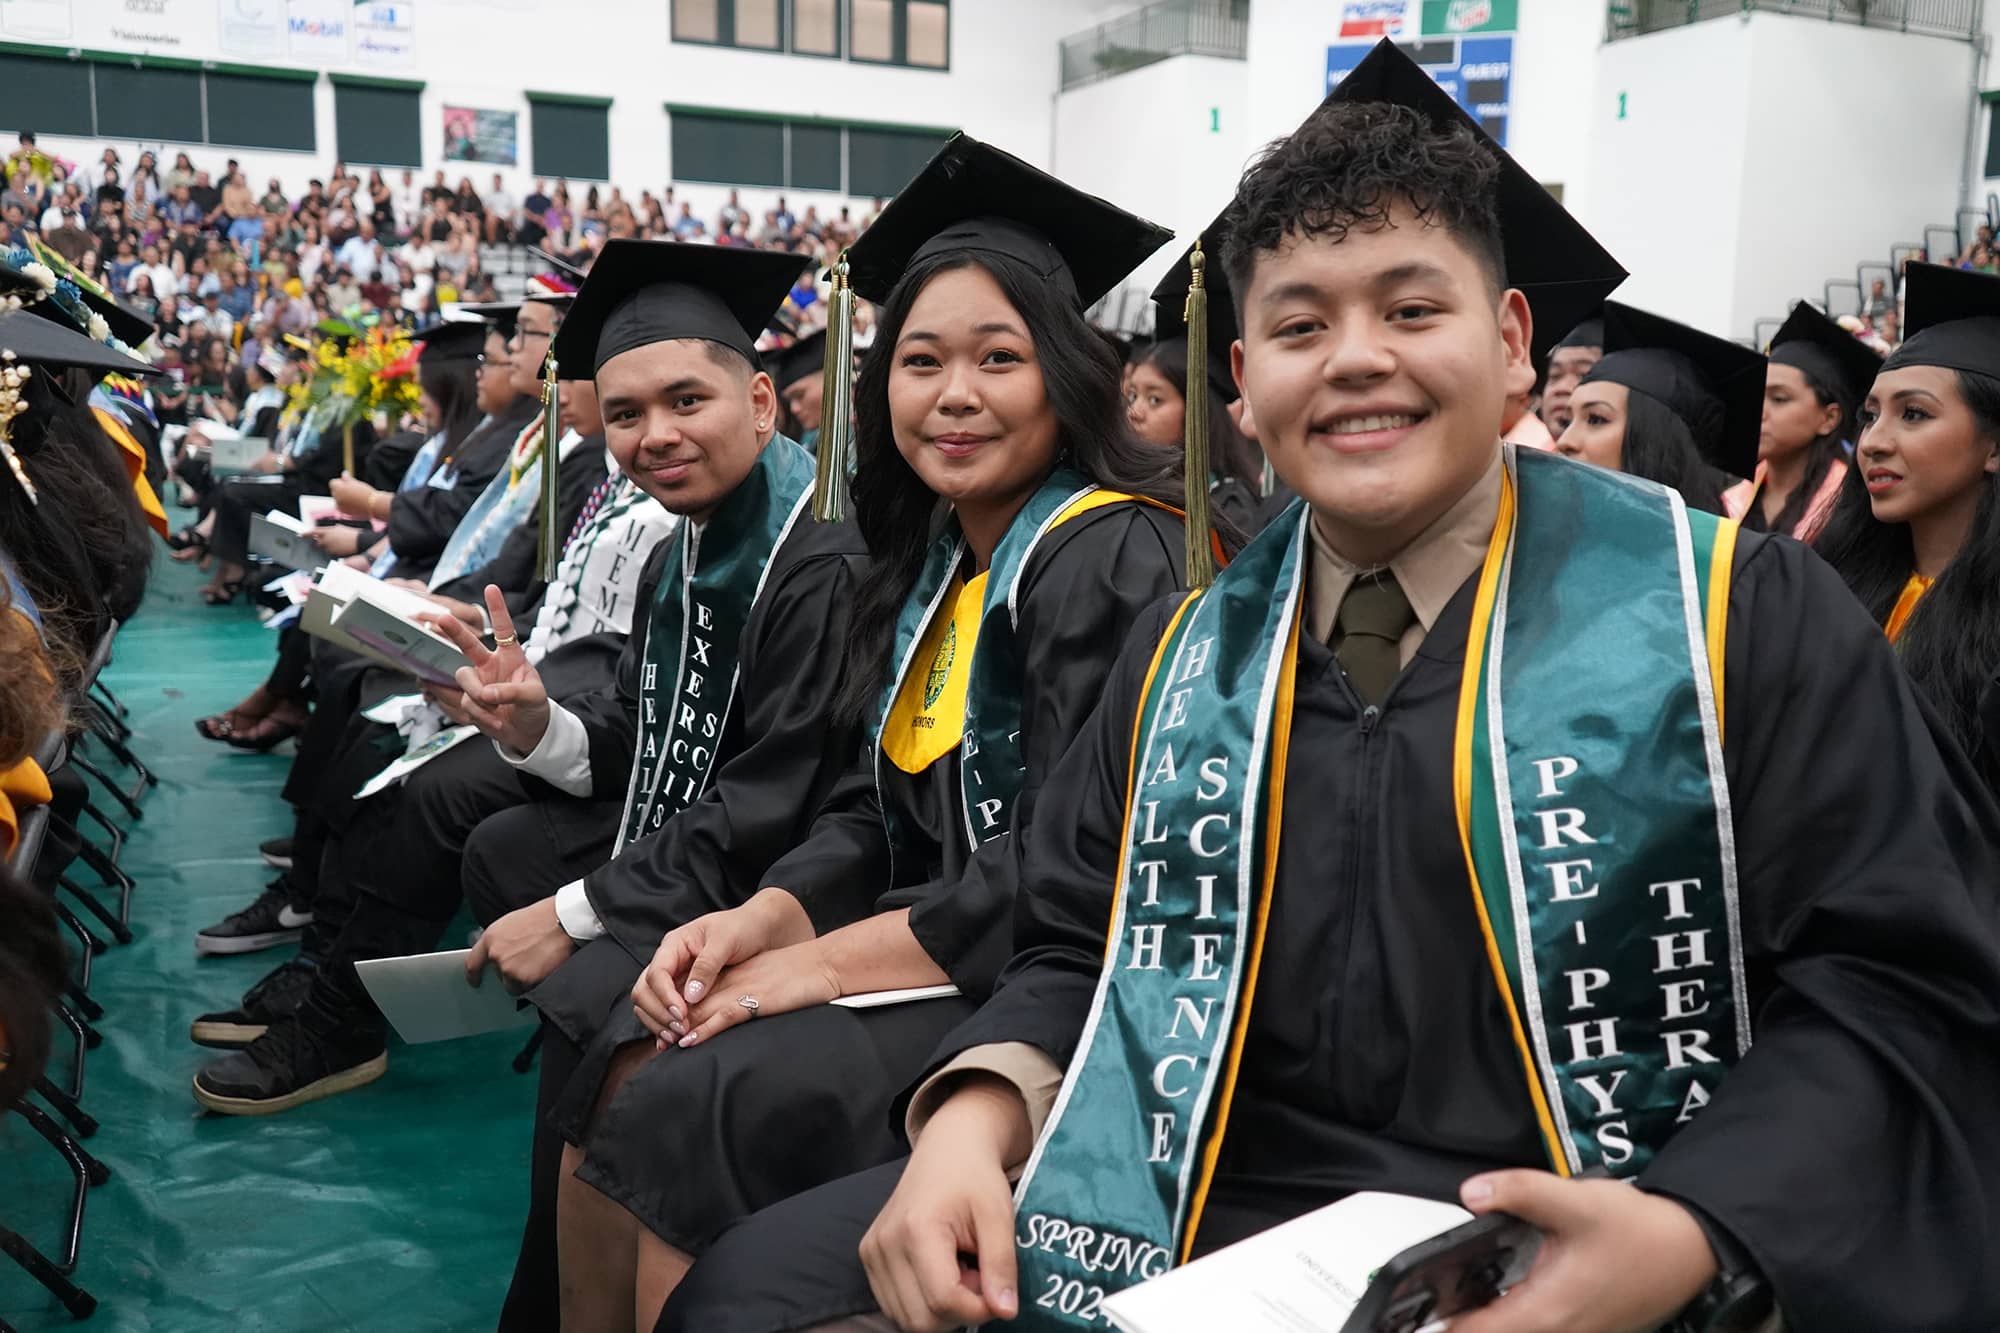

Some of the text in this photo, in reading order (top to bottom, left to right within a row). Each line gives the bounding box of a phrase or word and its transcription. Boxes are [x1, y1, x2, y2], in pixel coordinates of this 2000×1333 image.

[290, 19, 343, 36] Mobil
[1210, 107, 1221, 133] 1
[1618, 92, 1628, 119] 1
[629, 663, 658, 843] HEALT
[648, 602, 713, 833] EXERCIS
[911, 715, 936, 730] HONORS
[676, 713, 718, 814] SCI
[1125, 637, 1215, 970] HEALTH
[1146, 757, 1230, 1163] SCIENCE
[1531, 756, 1637, 1184] PRE-PHYS
[1016, 1213, 1170, 1280] SPRING
[1036, 1274, 1113, 1328] 202
